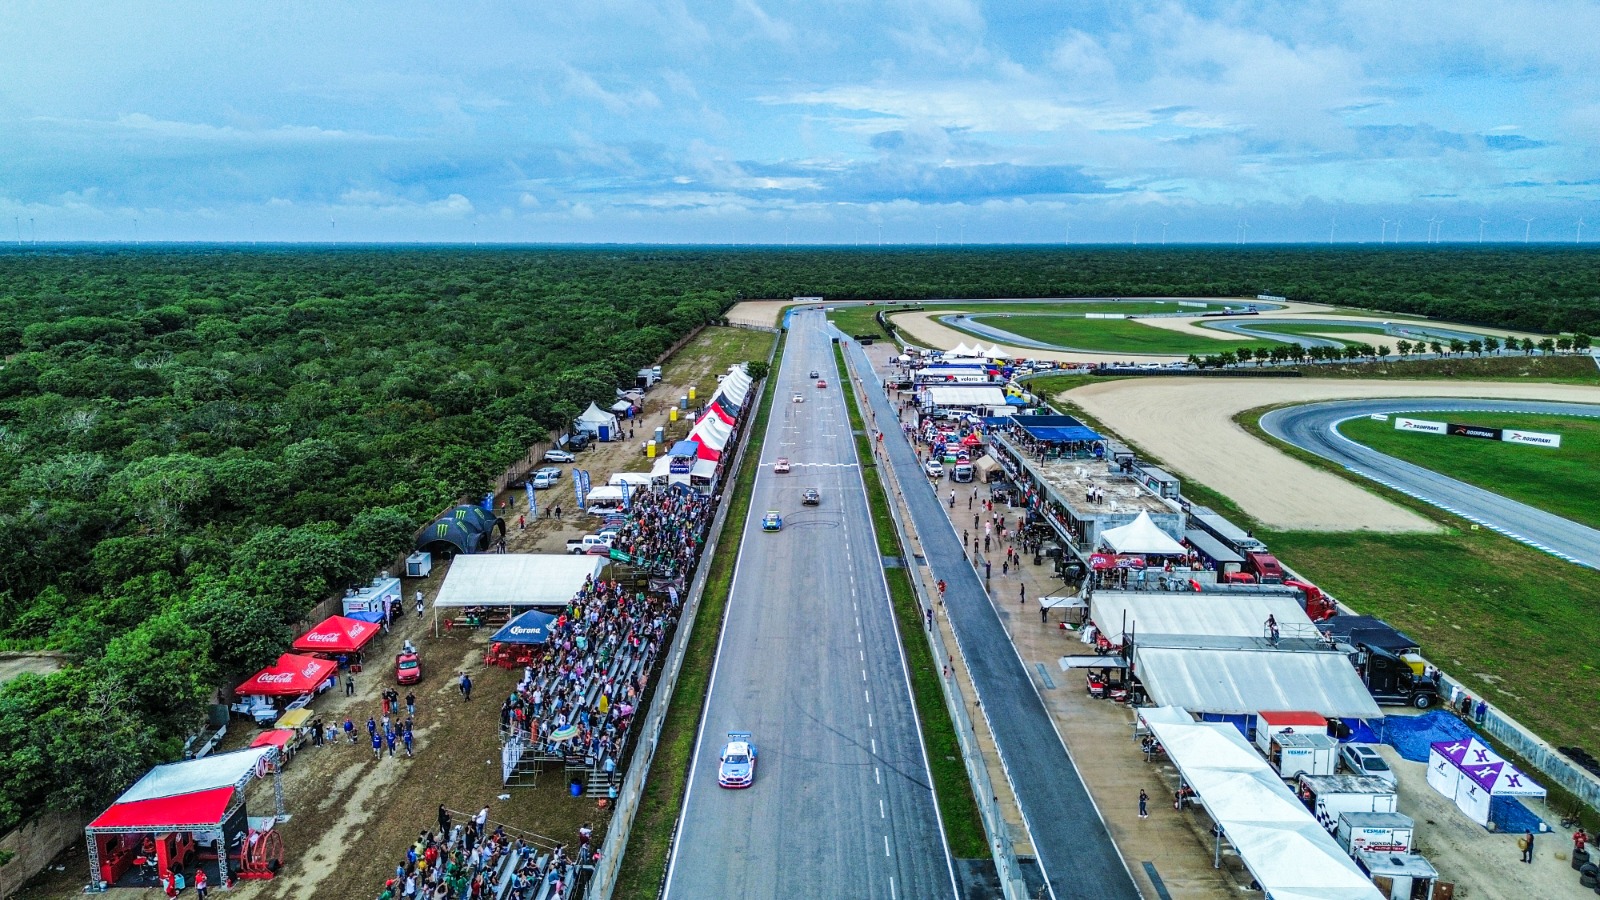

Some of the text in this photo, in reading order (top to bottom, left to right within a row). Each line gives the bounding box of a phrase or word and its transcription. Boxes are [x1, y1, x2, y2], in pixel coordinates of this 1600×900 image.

[510, 626, 541, 635] Corona
[307, 632, 340, 643] Coca-Cola
[257, 672, 295, 683] Coca-Cola
